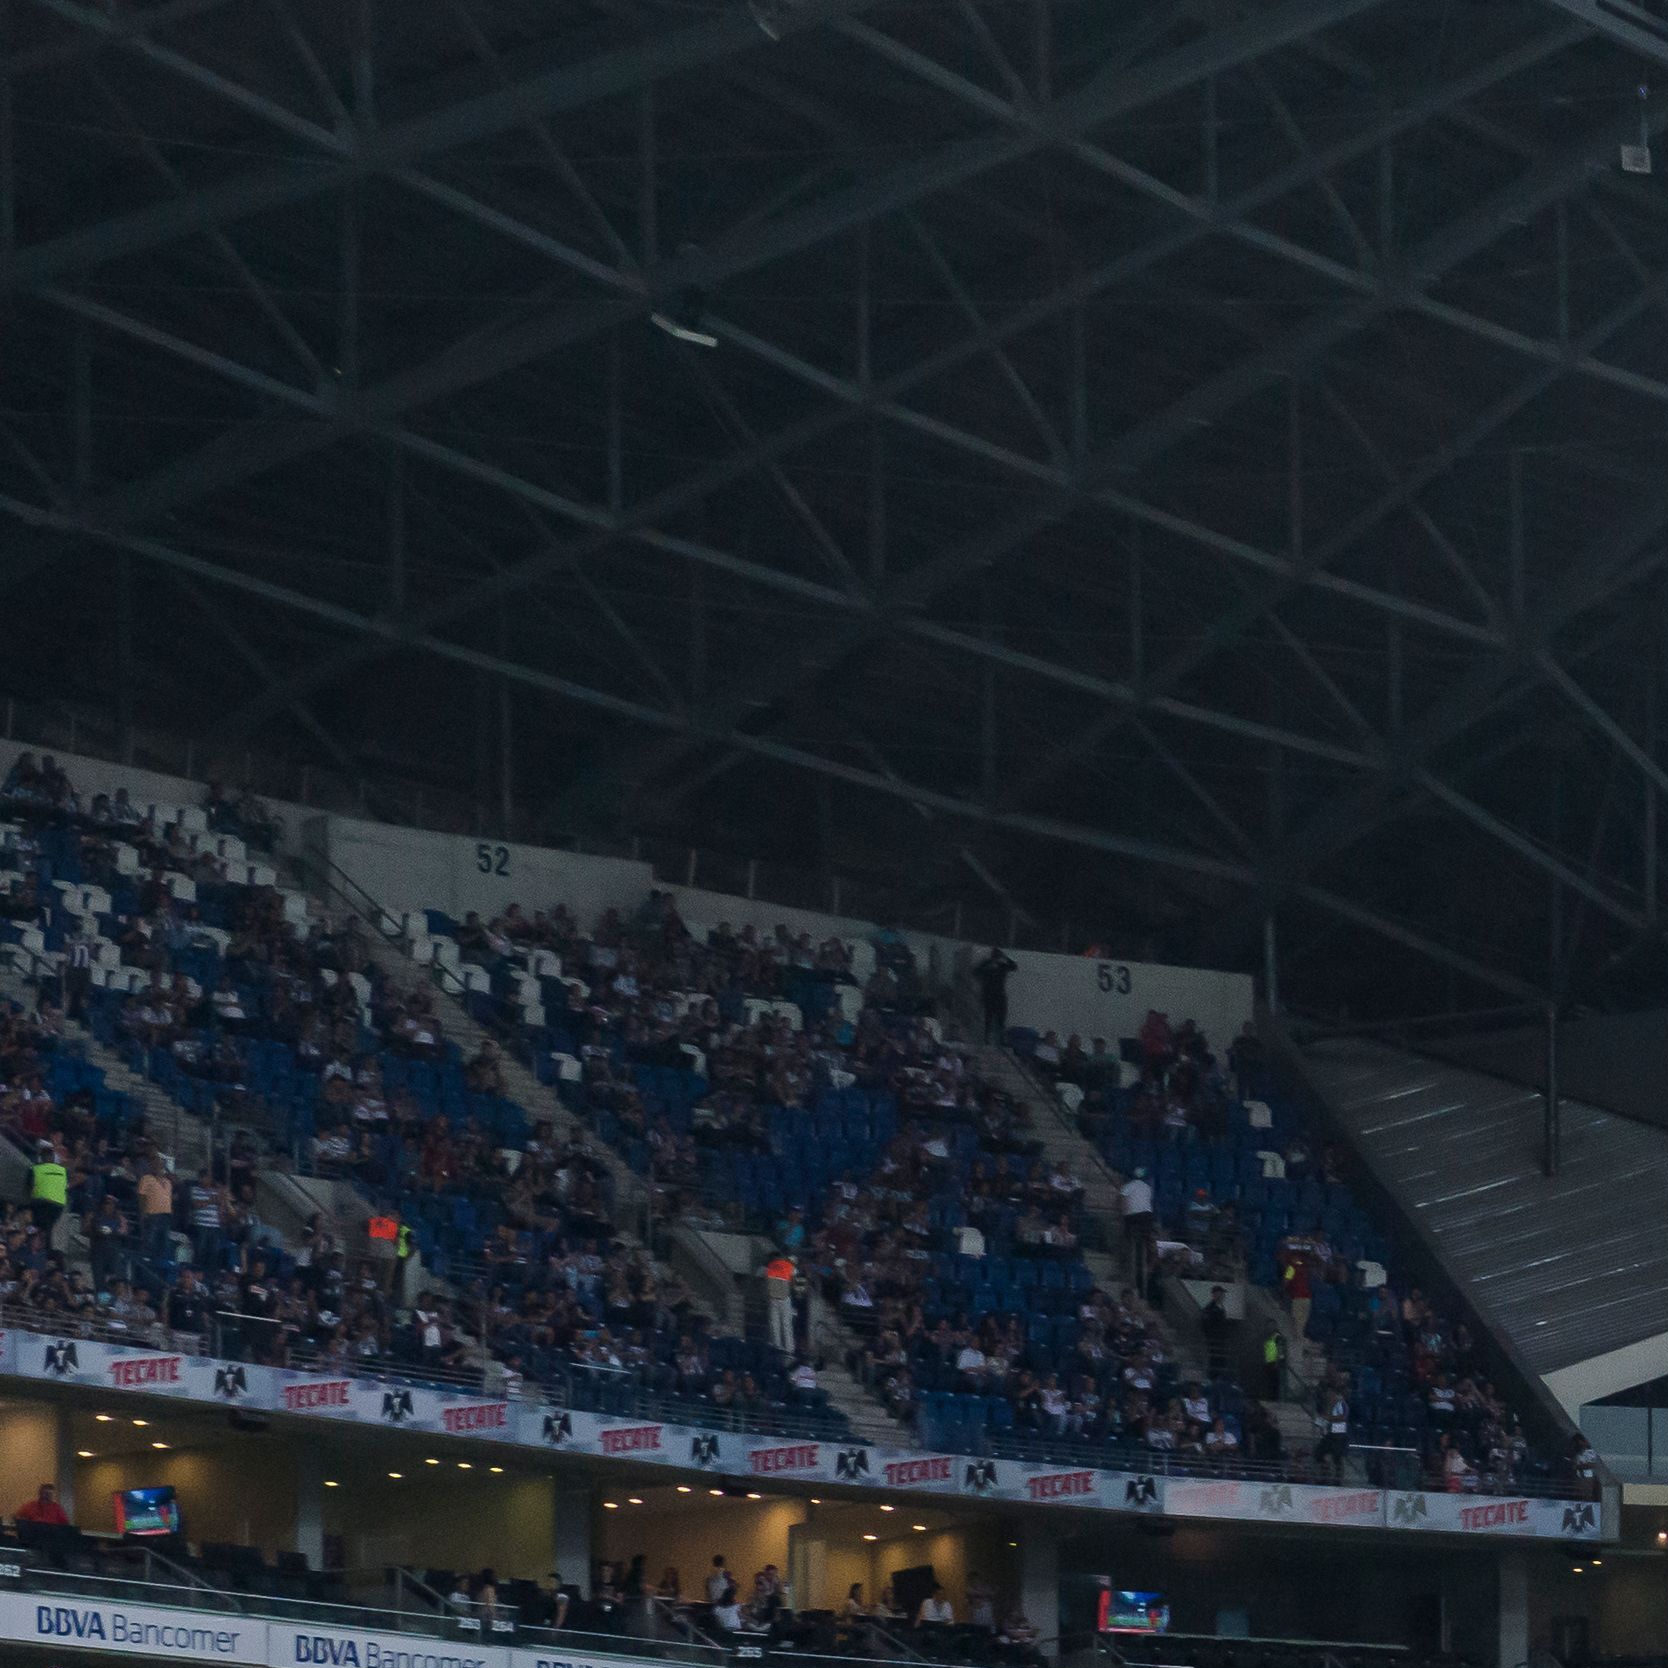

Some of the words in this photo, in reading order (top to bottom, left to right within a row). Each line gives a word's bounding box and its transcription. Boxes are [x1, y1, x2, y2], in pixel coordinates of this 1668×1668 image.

[476, 843, 511, 877] 52
[1097, 963, 1133, 996] 53
[109, 1356, 182, 1387] TECATE
[285, 1380, 350, 1409] TECATE
[598, 1425, 663, 1455] TECATE
[1028, 1471, 1094, 1499] TECATE
[1459, 1500, 1530, 1530] TECATE
[36, 1605, 107, 1641] BBVA
[112, 1613, 241, 1654] Bancomer
[295, 1634, 361, 1668] BBVA
